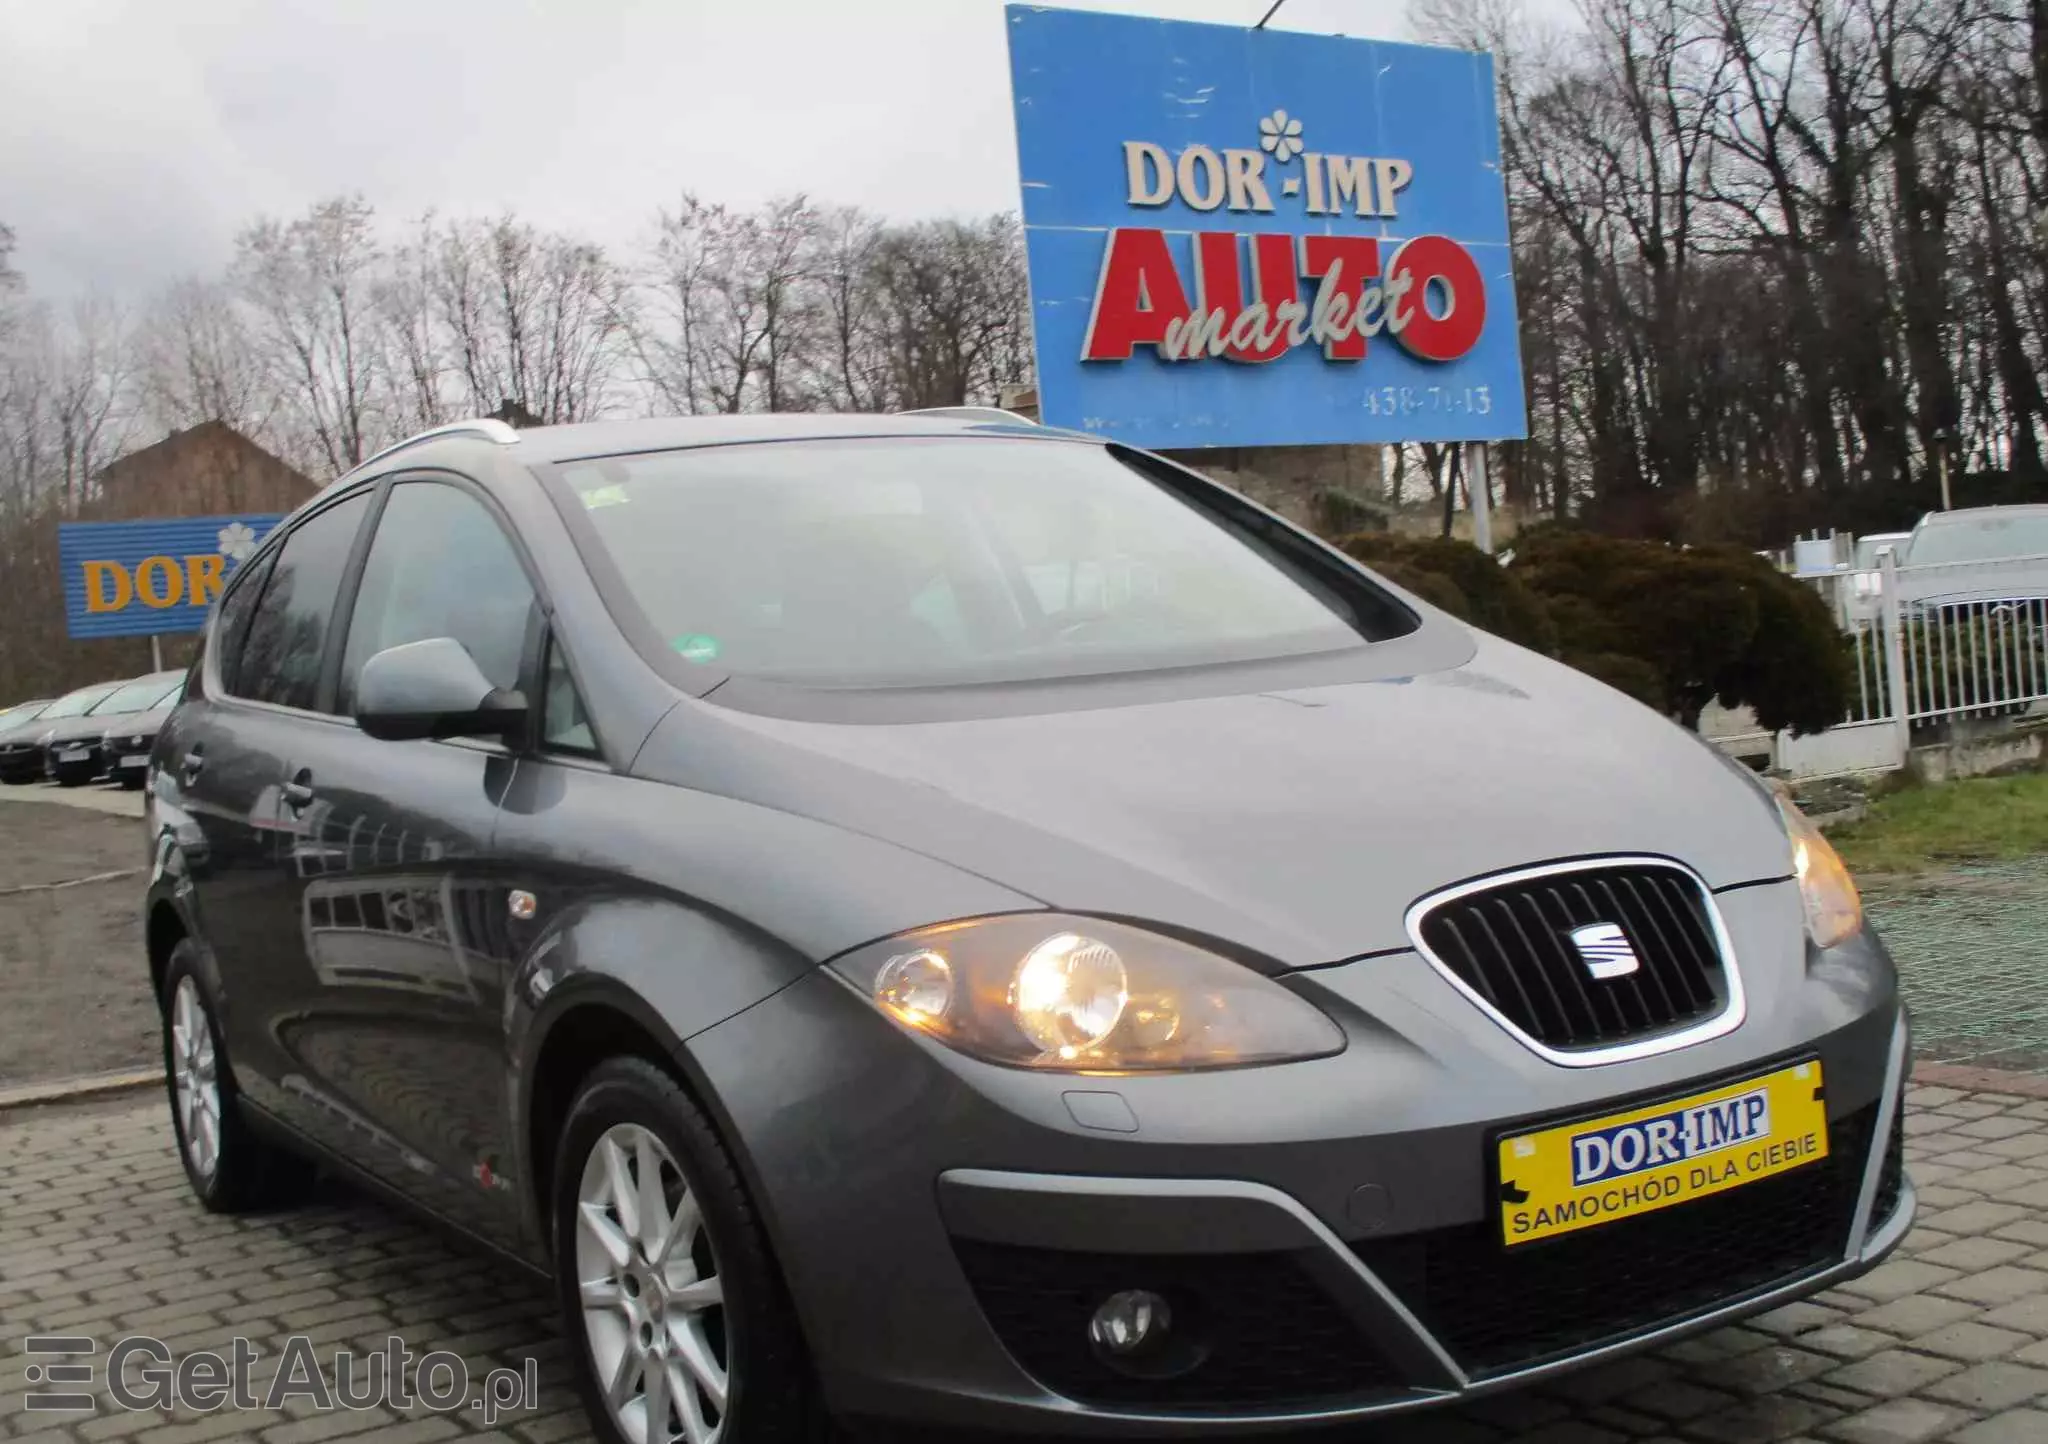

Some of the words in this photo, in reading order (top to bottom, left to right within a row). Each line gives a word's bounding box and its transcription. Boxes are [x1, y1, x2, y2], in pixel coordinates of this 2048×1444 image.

[1122, 141, 1413, 217] DOR-IMP
[1081, 227, 1487, 363] AUTO
[1163, 257, 1416, 362] market
[1512, 1174, 1681, 1235] SAMOCHÓD
[1690, 1160, 1740, 1190] DLA
[1746, 1132, 1817, 1173] CIEBIE
[1573, 1094, 1766, 1183] DOR-IMP
